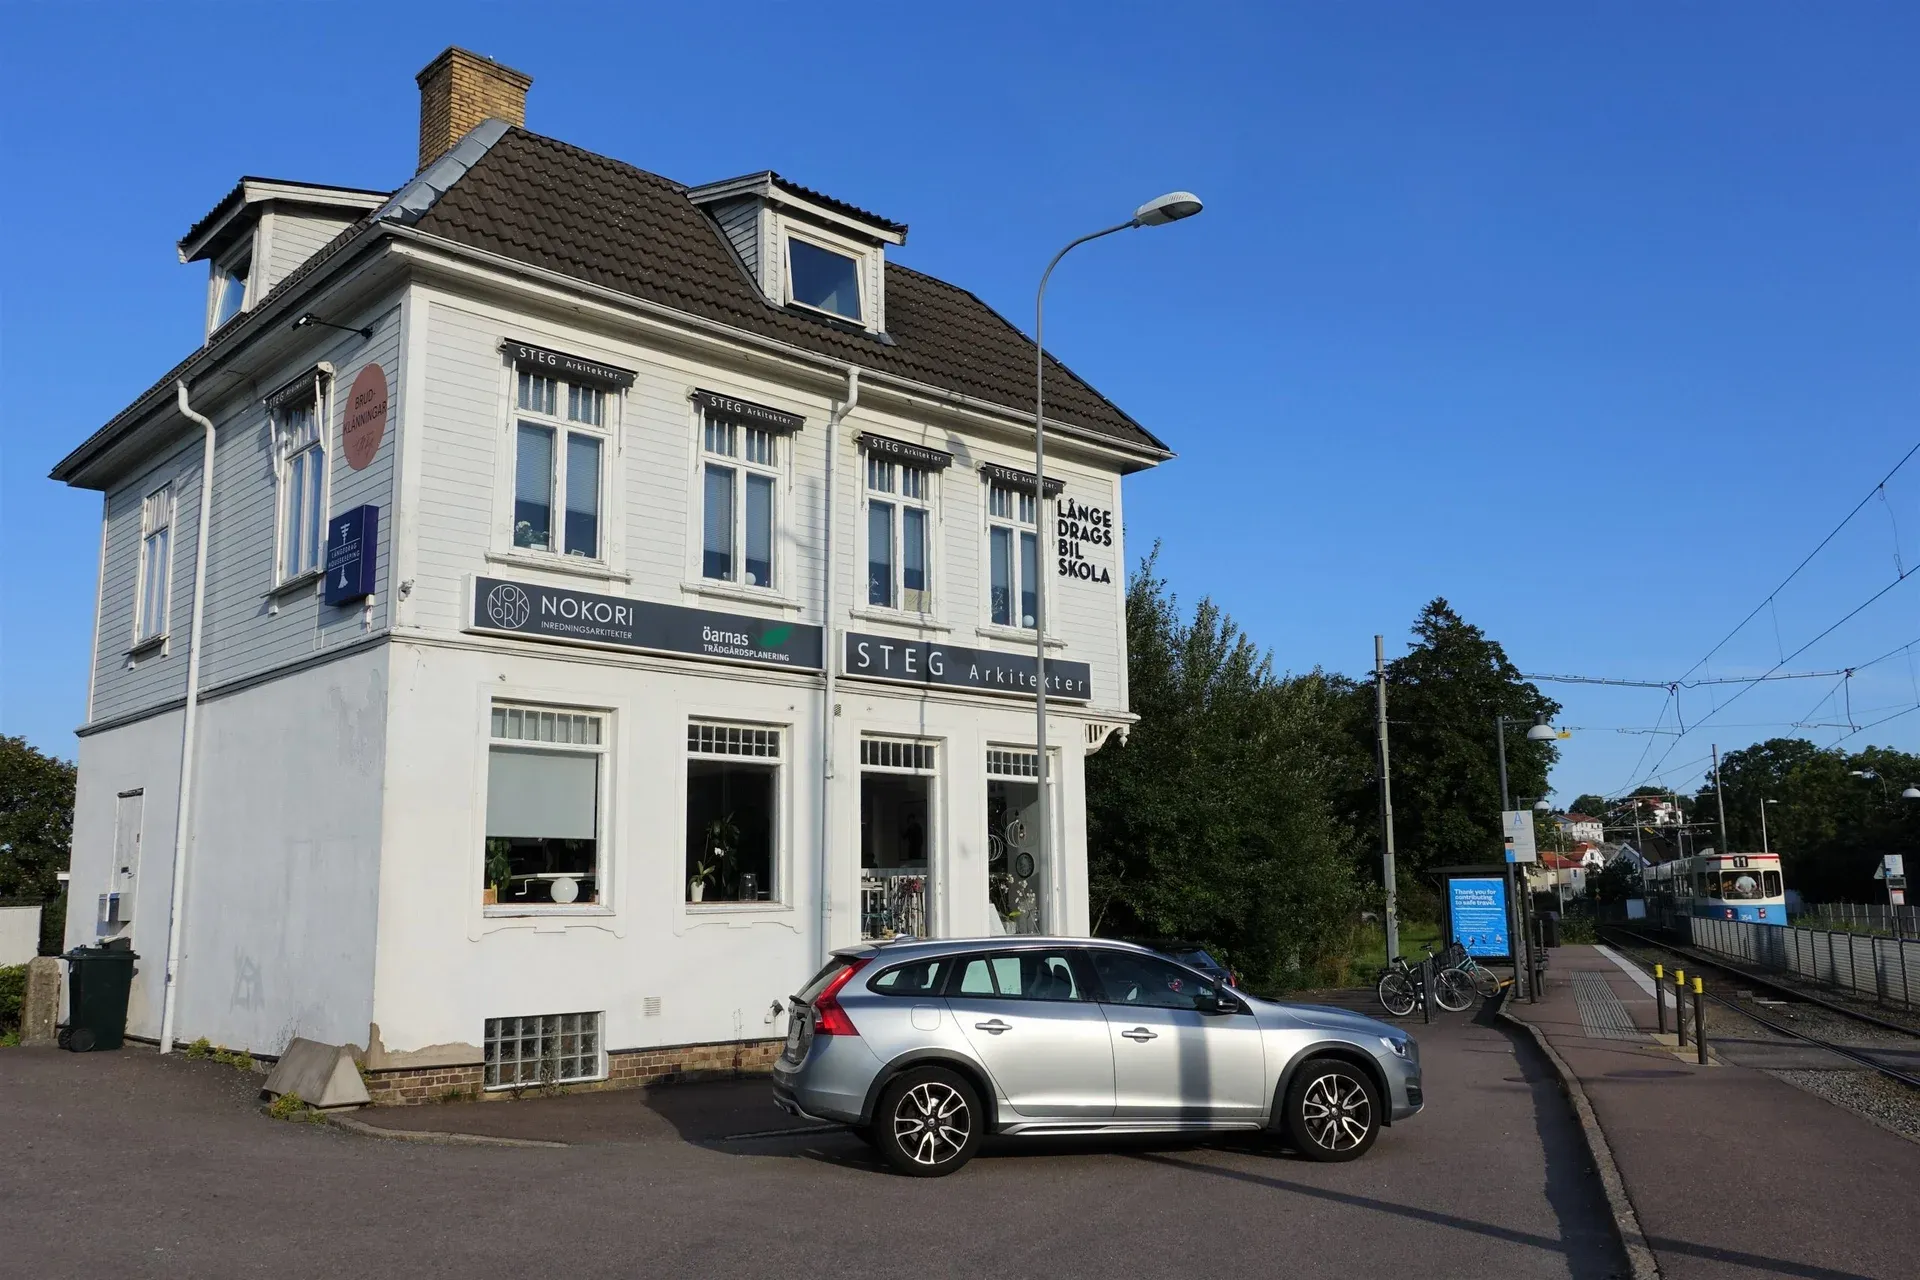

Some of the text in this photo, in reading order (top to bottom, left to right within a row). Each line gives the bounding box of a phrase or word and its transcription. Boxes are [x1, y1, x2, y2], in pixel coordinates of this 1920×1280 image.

[520, 347, 556, 366] STEG
[354, 388, 377, 410] BRUD-
[711, 396, 742, 413] STEG
[872, 438, 899, 453] STEG
[995, 468, 1018, 481] STEG
[1057, 498, 1112, 528] LÅNGE
[1057, 519, 1112, 547] DRAGS
[1058, 538, 1085, 560] BIL
[1058, 557, 1111, 584] SKOLA
[541, 595, 633, 627] NOKORI
[541, 620, 633, 640] INREDNINGSARKITEKTER
[702, 625, 749, 646] öarnas
[703, 643, 790, 662] TRÄDGÅRDSPLANERING
[857, 642, 944, 676] STEG
[1514, 811, 1523, 825] A
[1734, 856, 1746, 867] 11
